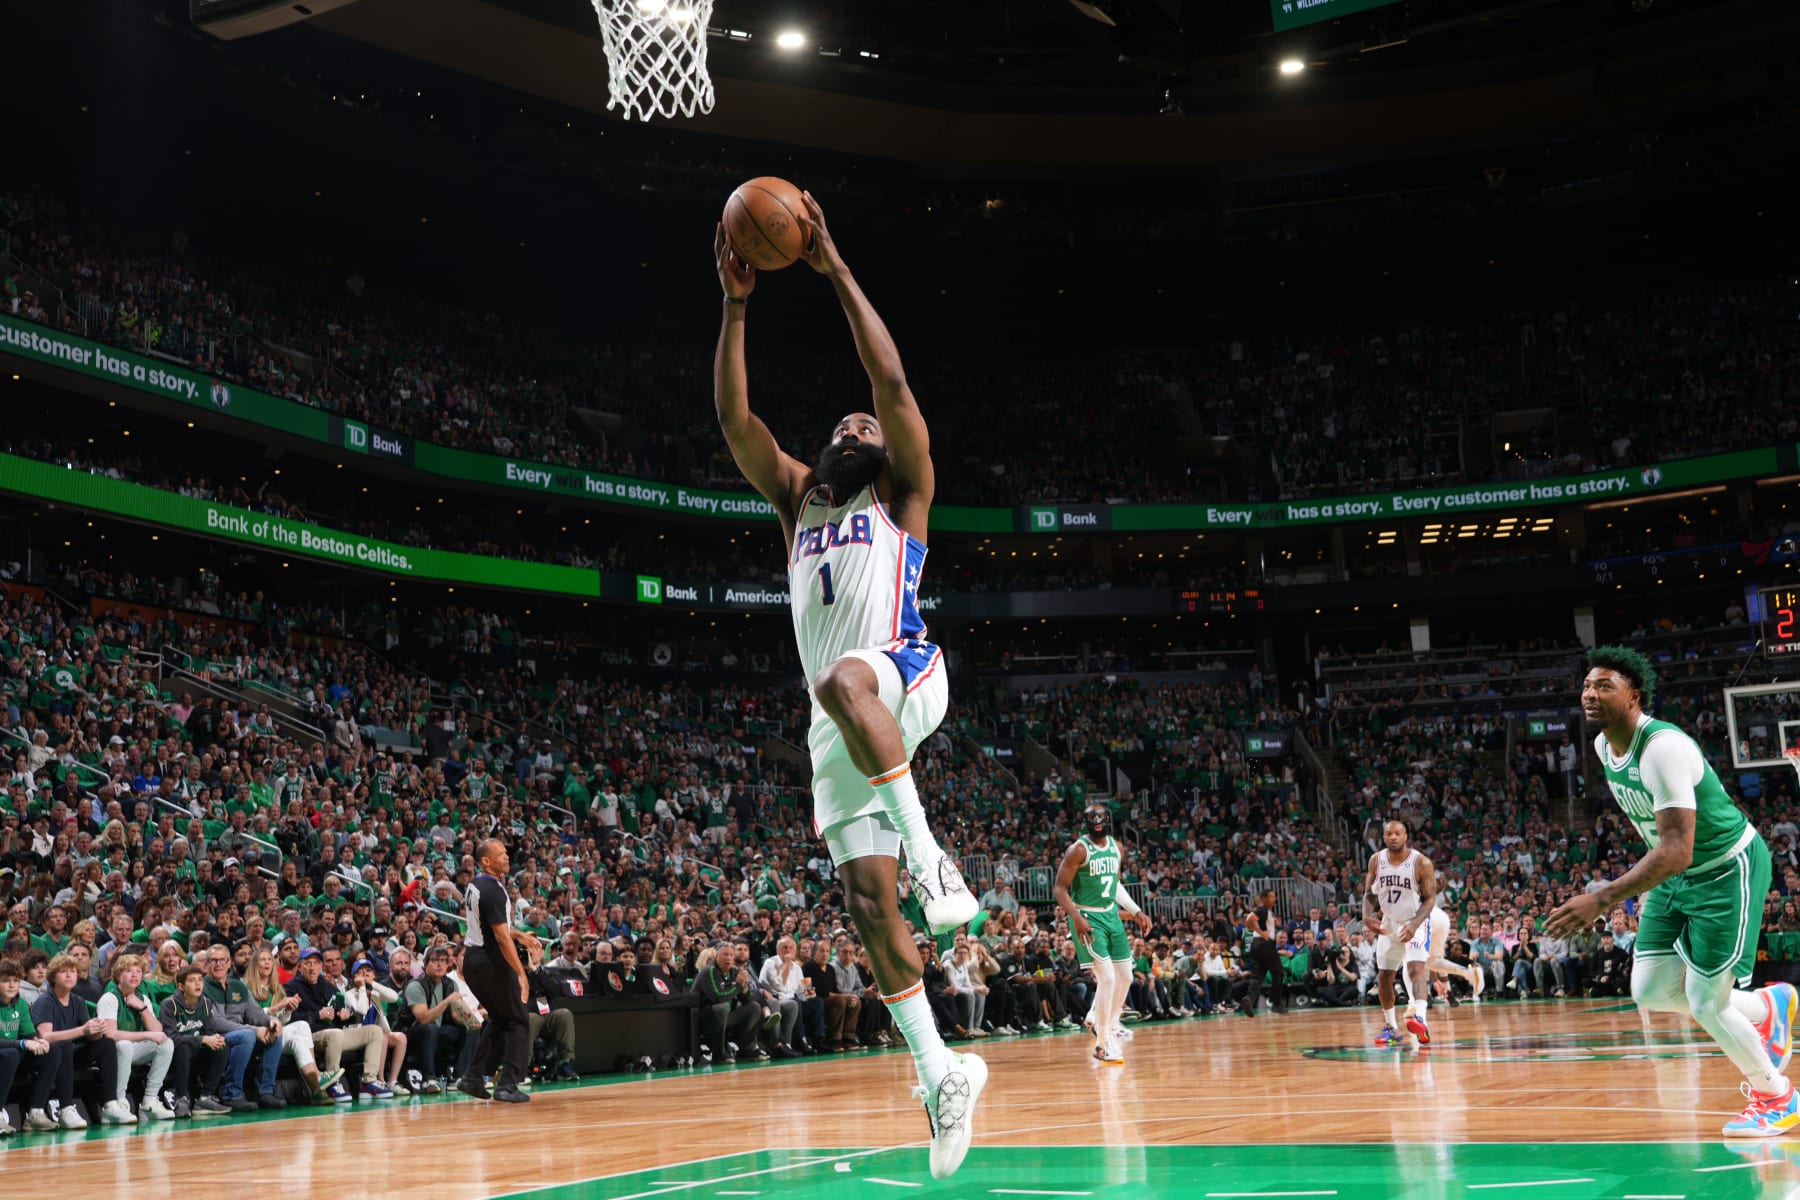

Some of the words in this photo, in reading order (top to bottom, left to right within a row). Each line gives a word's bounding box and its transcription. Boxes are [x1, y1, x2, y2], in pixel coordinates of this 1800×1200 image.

[96, 348, 130, 377] has
[133, 364, 146, 382] a
[149, 367, 200, 398] story.
[346, 424, 366, 446] TD
[373, 434, 402, 457] Bank
[506, 463, 552, 488] Every
[586, 476, 613, 496] has
[616, 484, 627, 496] a
[628, 484, 670, 505] story.
[678, 490, 718, 514] Every
[722, 496, 777, 514] custom
[1392, 495, 1440, 513] Every
[1444, 487, 1528, 506] customer
[1530, 484, 1562, 500] has
[1565, 483, 1578, 496] a
[1580, 474, 1630, 496] story.
[1033, 511, 1055, 527] TD
[1063, 512, 1098, 526] Bank
[1207, 508, 1252, 526] Every
[1288, 504, 1318, 520] has
[1321, 504, 1333, 516] a
[1336, 500, 1382, 519] story.
[208, 508, 248, 534] Bank
[252, 520, 269, 539] of
[272, 524, 298, 545] the
[301, 529, 354, 558] Boston
[356, 543, 413, 570] Celtics.
[640, 580, 660, 599] TD
[666, 585, 698, 602] Bank
[724, 588, 790, 604] America's
[818, 562, 836, 606] 1
[1547, 722, 1566, 731] Bank
[1264, 740, 1282, 748] Bank
[1100, 876, 1114, 898] 7
[1380, 876, 1412, 890] PHILA
[1387, 890, 1402, 904] 17
